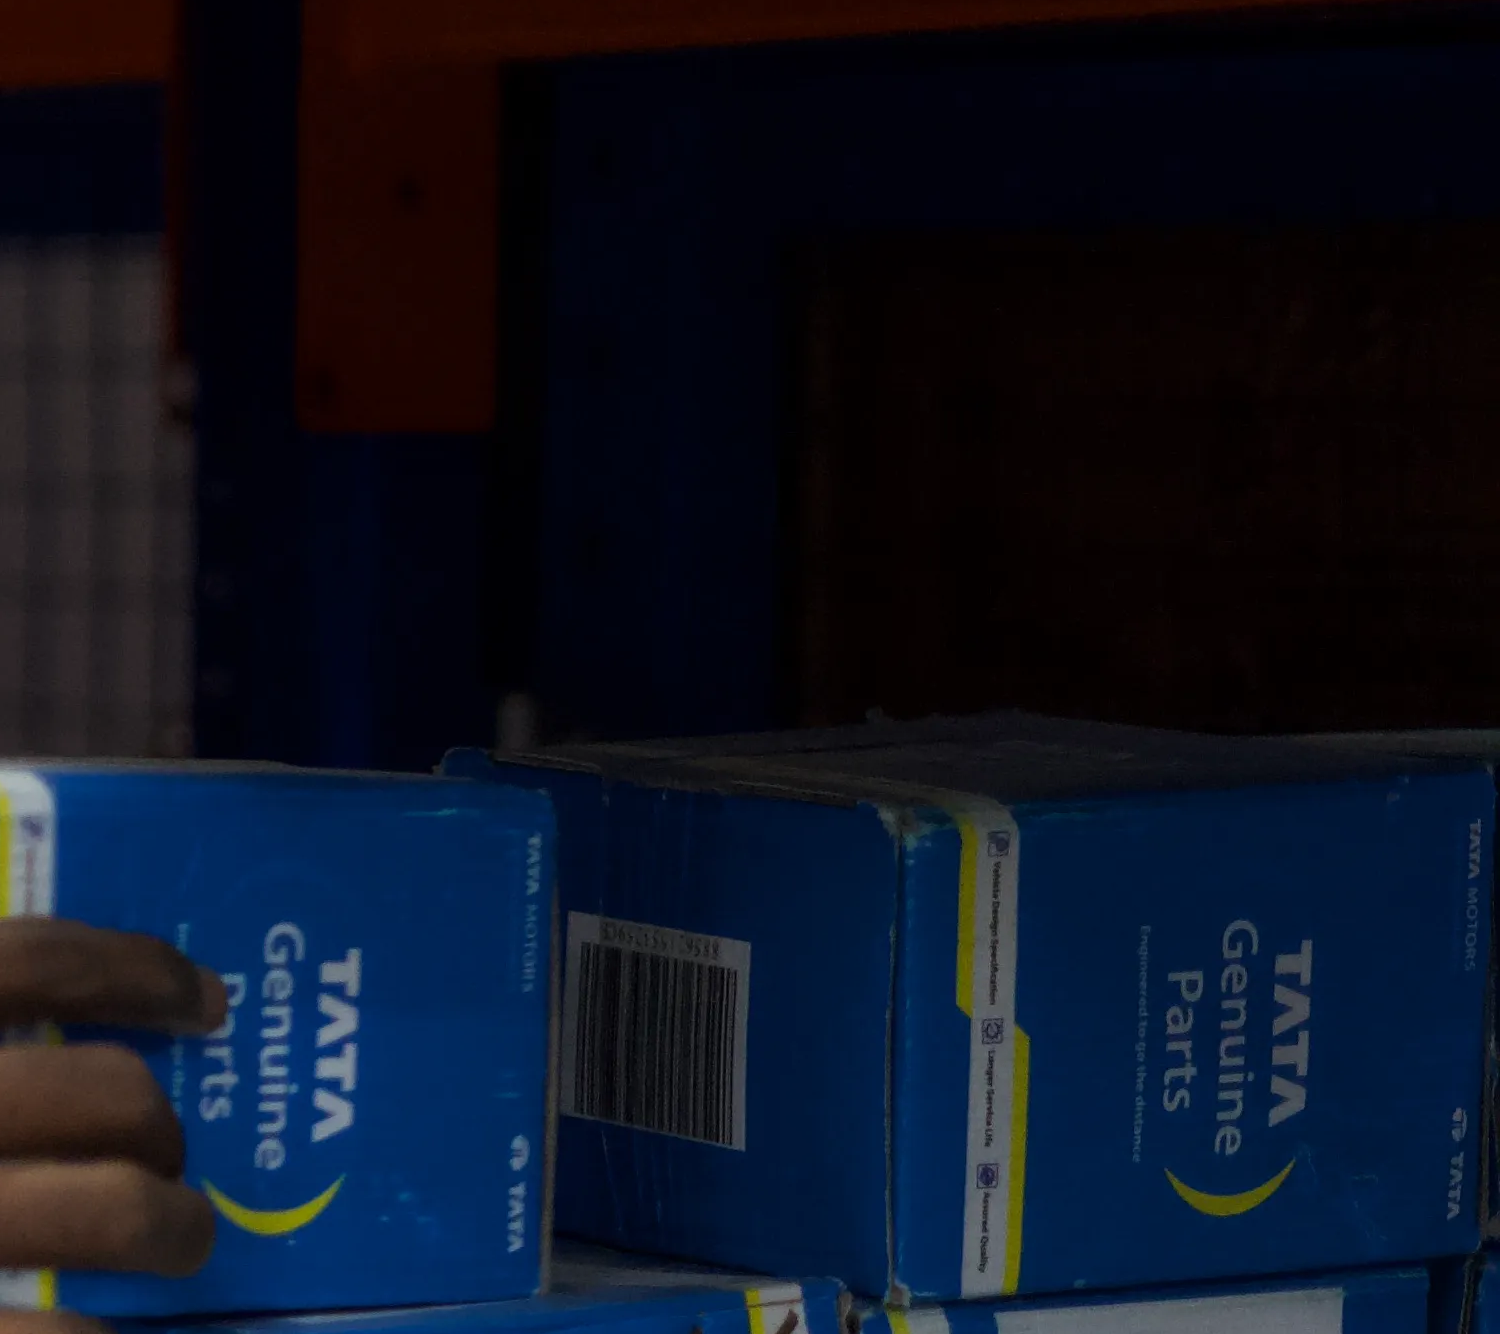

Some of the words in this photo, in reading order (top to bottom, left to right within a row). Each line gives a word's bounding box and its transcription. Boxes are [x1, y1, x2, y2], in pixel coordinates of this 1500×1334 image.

[524, 832, 543, 896] TATA
[1466, 818, 1482, 879] TATA
[520, 904, 539, 994] MOTORS
[1135, 925, 1152, 1017] Engineered
[1464, 887, 1479, 971] MOTORS
[253, 921, 306, 1171] Genuine
[310, 947, 362, 1143] TATA
[1162, 969, 1204, 1112] Parts
[1213, 918, 1259, 1157] Genuine
[1268, 939, 1313, 1128] TATA
[1134, 1065, 1148, 1092] the
[1131, 1095, 1146, 1163] distance
[506, 1181, 527, 1253] TATA
[1446, 1151, 1465, 1221] TATA
